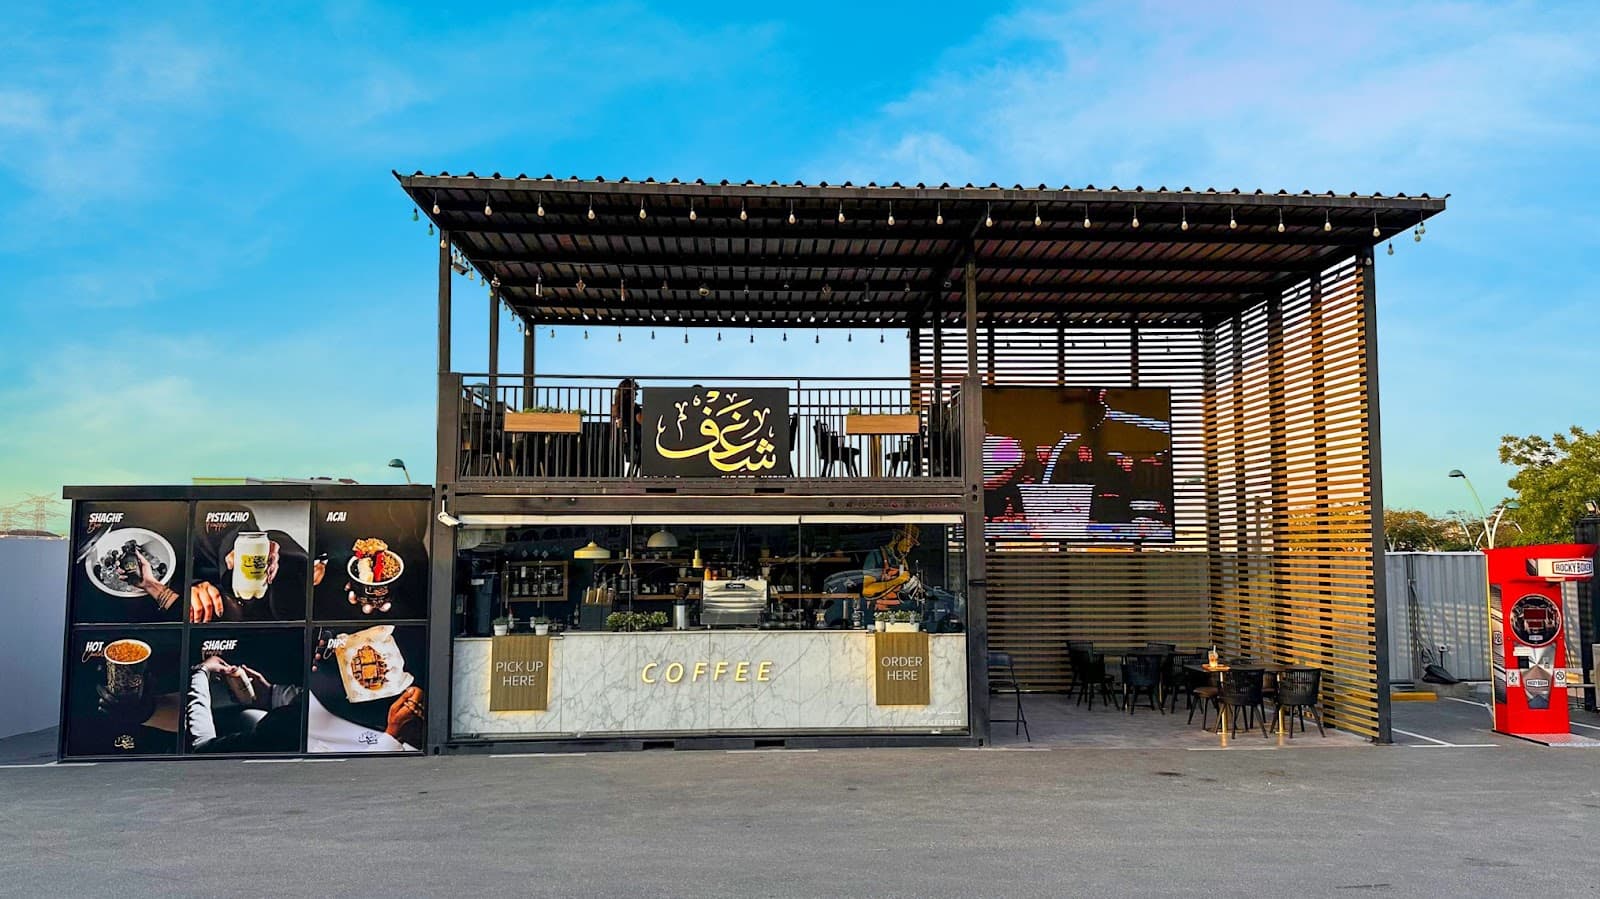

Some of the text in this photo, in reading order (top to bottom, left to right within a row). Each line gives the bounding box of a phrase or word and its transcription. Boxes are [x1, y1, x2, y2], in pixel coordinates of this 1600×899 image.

[88, 512, 124, 523] SHAGHF
[205, 511, 250, 522] PISTACHIO
[326, 511, 347, 522] ACAI
[1555, 563, 1576, 573] ROCKY
[85, 641, 104, 652] HOT
[202, 640, 238, 651] SHAGHF
[496, 660, 544, 673] PICK UP
[881, 656, 923, 667] ORDER
[641, 661, 773, 684] COFFEE
[887, 670, 918, 681] HERE
[503, 675, 536, 686] HERE
